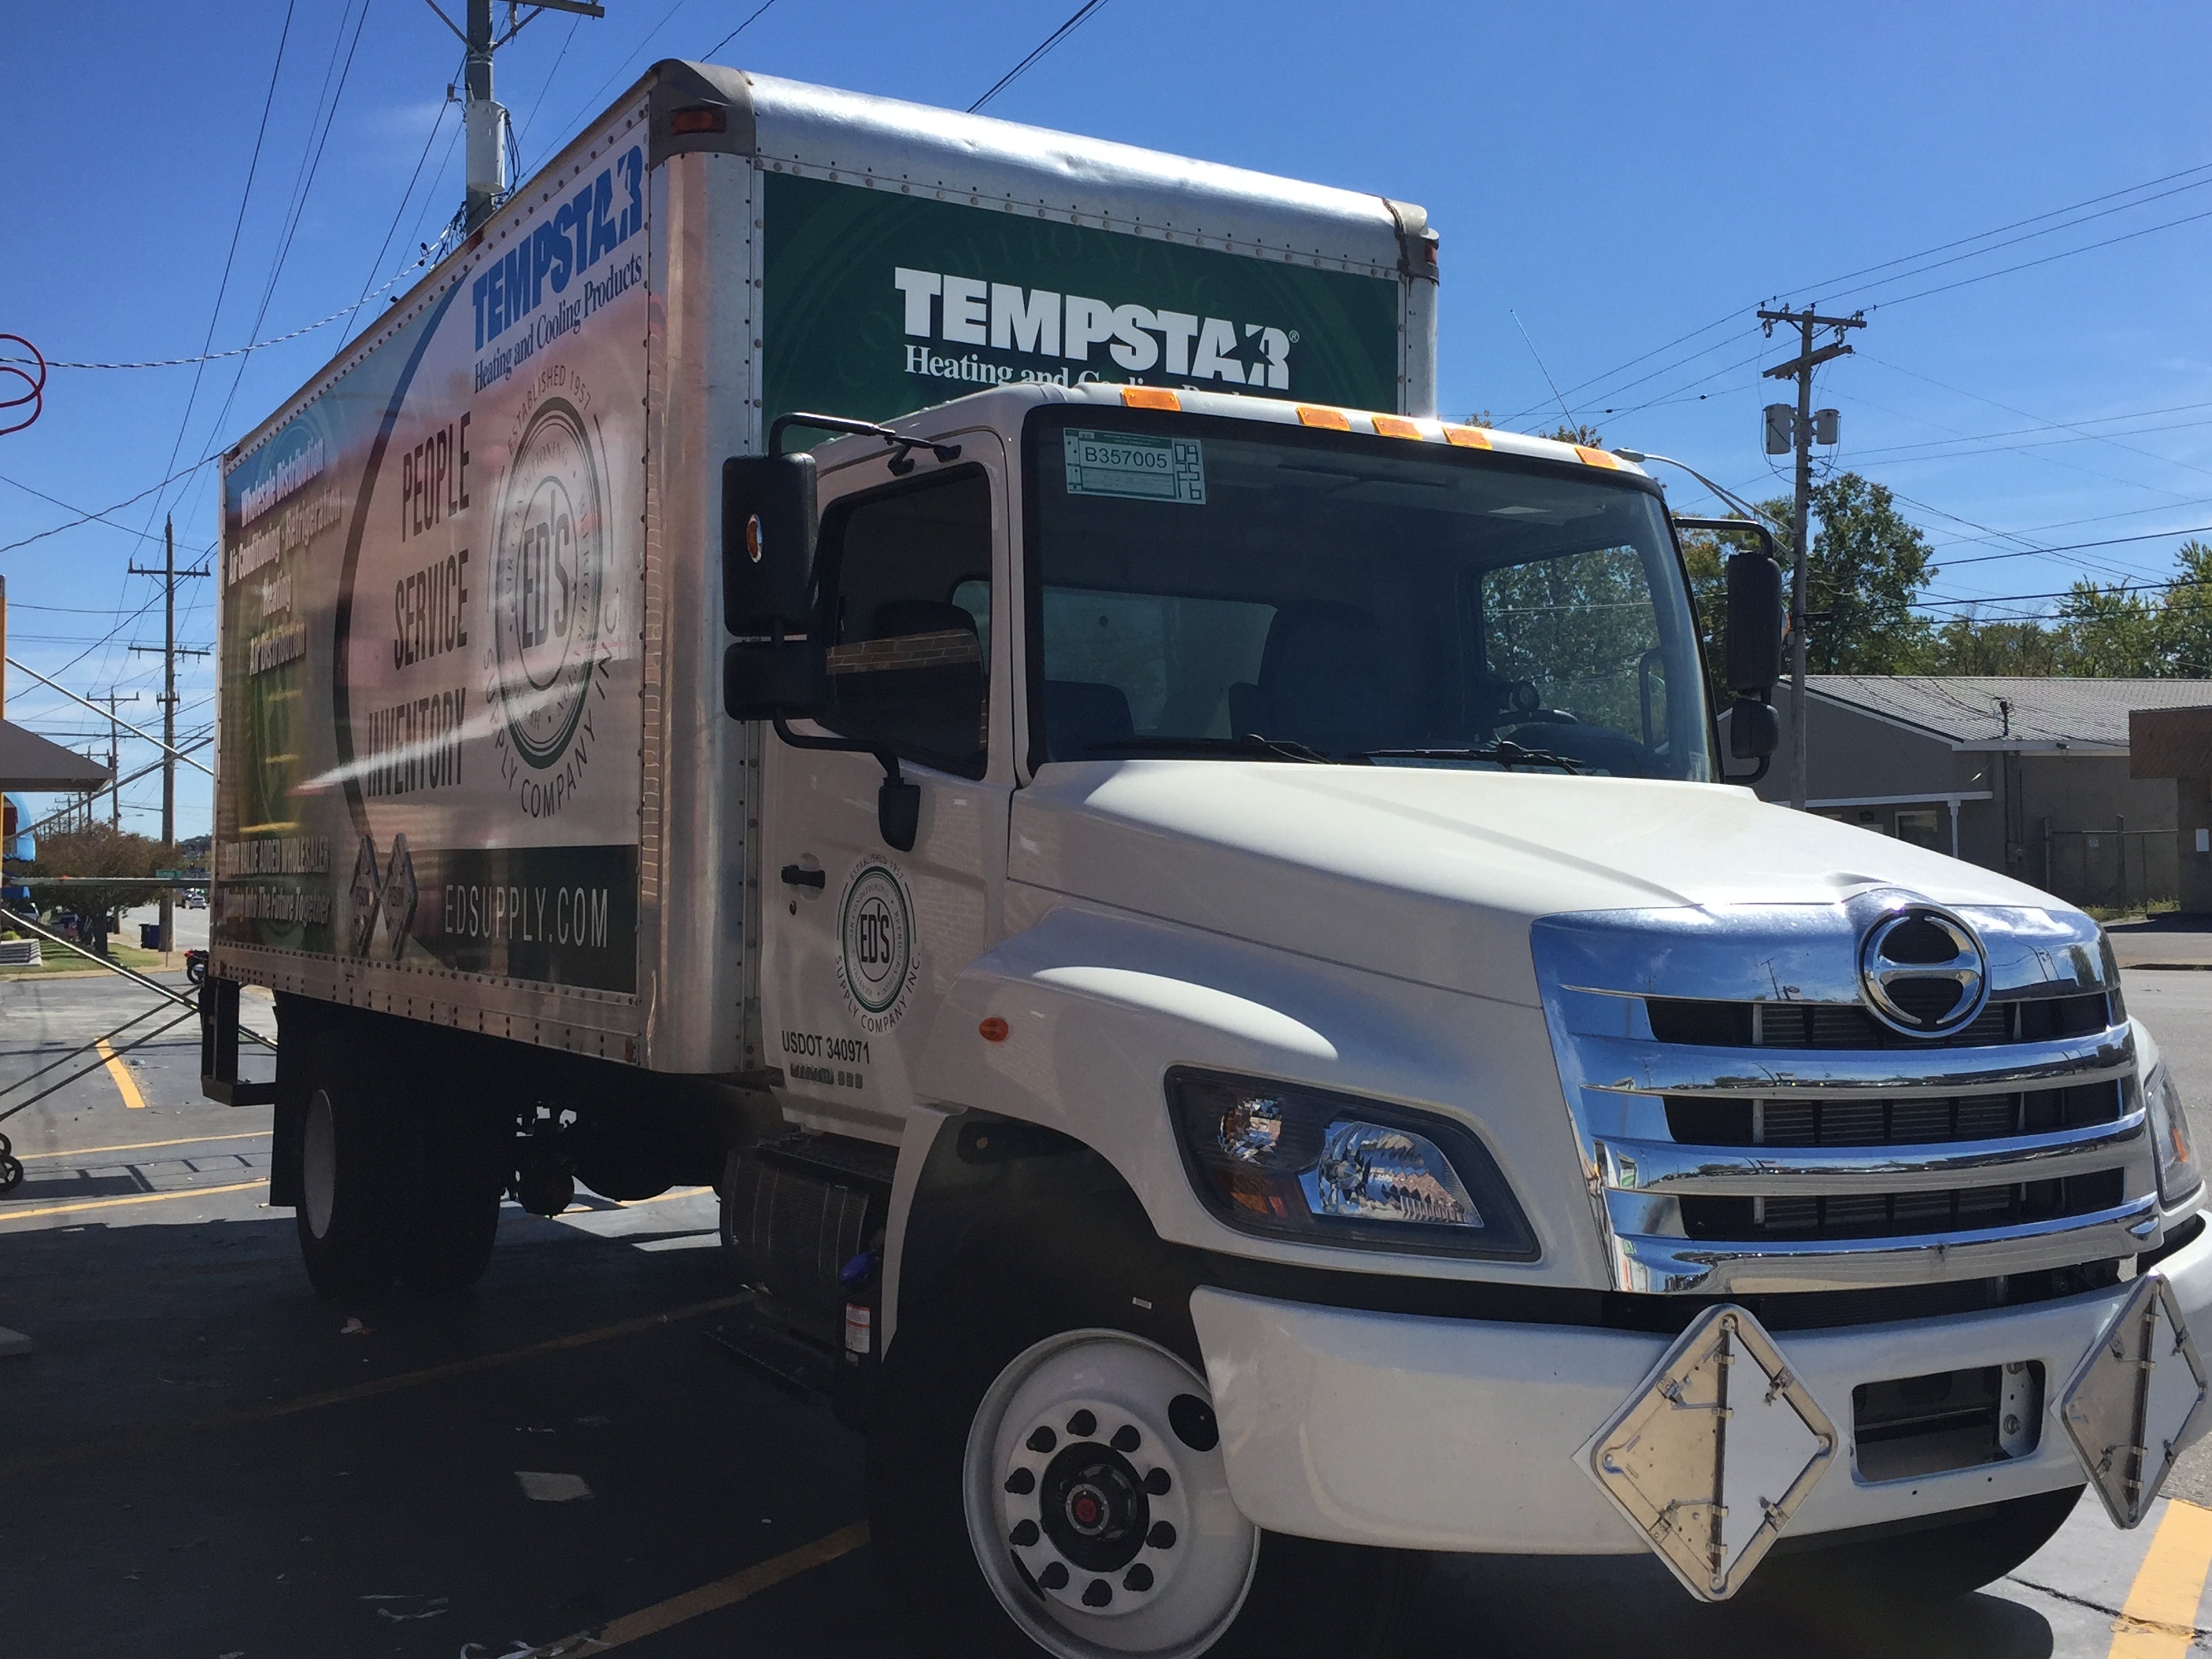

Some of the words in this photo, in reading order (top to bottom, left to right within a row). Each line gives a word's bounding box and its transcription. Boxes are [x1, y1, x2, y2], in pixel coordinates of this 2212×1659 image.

[472, 144, 642, 353] TEMPSTAR
[474, 352, 512, 394] Heating
[514, 331, 533, 362] and
[537, 299, 581, 350] Cooling
[583, 253, 642, 315] Products
[905, 344, 1013, 385] Heating
[509, 365, 566, 455] ESTABLISHED
[570, 371, 591, 410] 1957
[402, 412, 470, 540] PEOPLE
[1086, 447, 1167, 468] B357005
[286, 483, 340, 551] Refrigeration
[393, 549, 468, 671] SERVICE
[522, 489, 569, 649] ED'S
[367, 688, 466, 797] INVENTORY
[521, 709, 595, 819] COMPANY
[445, 886, 609, 947] EDSUPPLY.COM
[861, 903, 891, 964] ED'S
[835, 955, 859, 1018] SUPPLY
[861, 995, 907, 1033] COMPANY
[905, 952, 921, 994] INC.
[781, 1030, 822, 1057] USDOT
[826, 1036, 870, 1064] 340971
